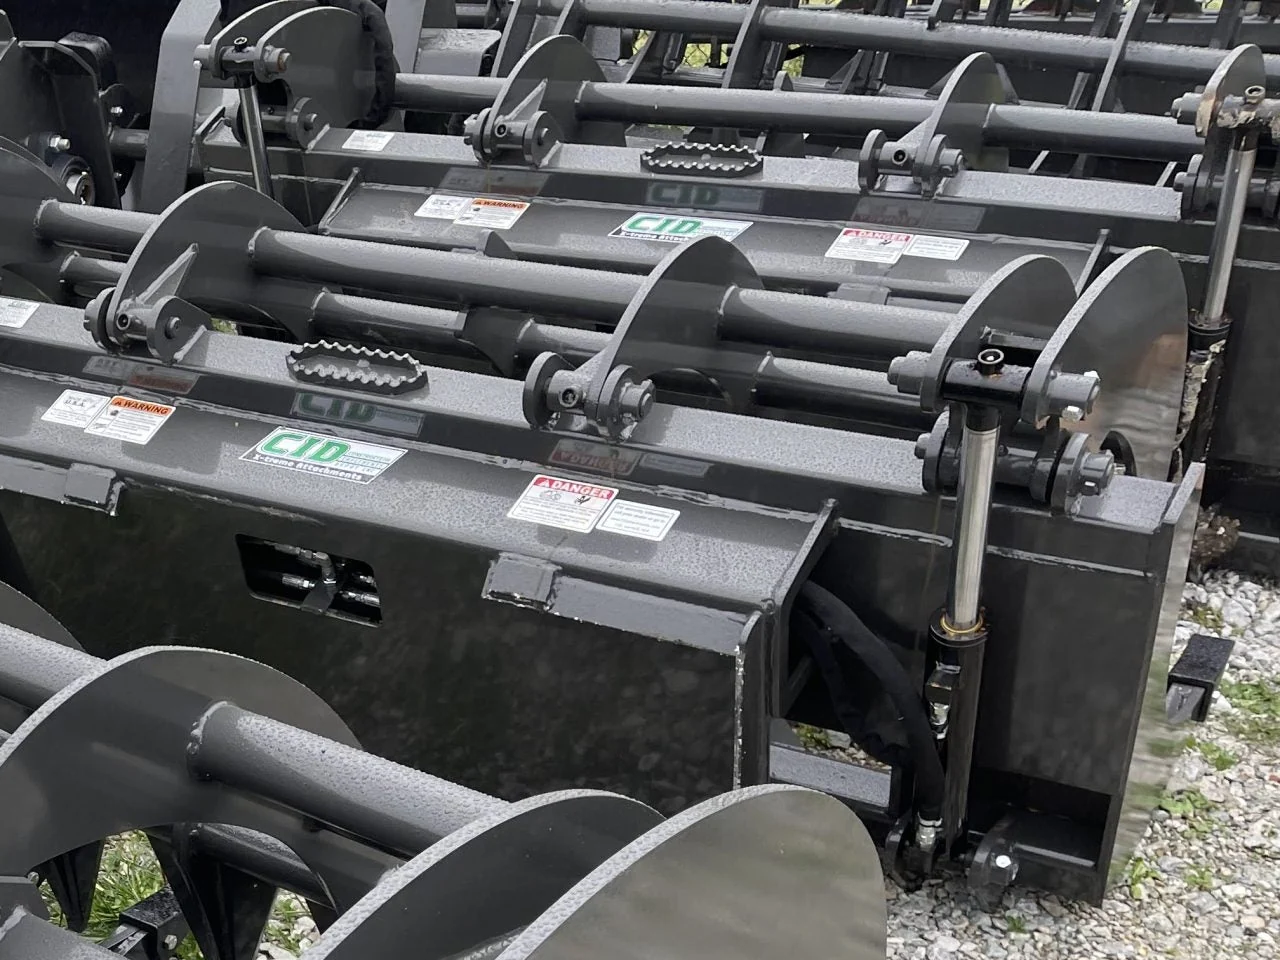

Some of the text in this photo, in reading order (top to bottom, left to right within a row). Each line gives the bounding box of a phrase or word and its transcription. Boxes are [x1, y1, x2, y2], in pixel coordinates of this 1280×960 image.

[484, 200, 523, 209] WARNING
[627, 217, 703, 234] CID
[859, 231, 908, 242] DANGER
[123, 400, 169, 415] WARNING
[261, 431, 351, 463] CID
[252, 453, 294, 467] X-treme
[295, 462, 362, 481] Attachments
[552, 481, 611, 499] DANGER
